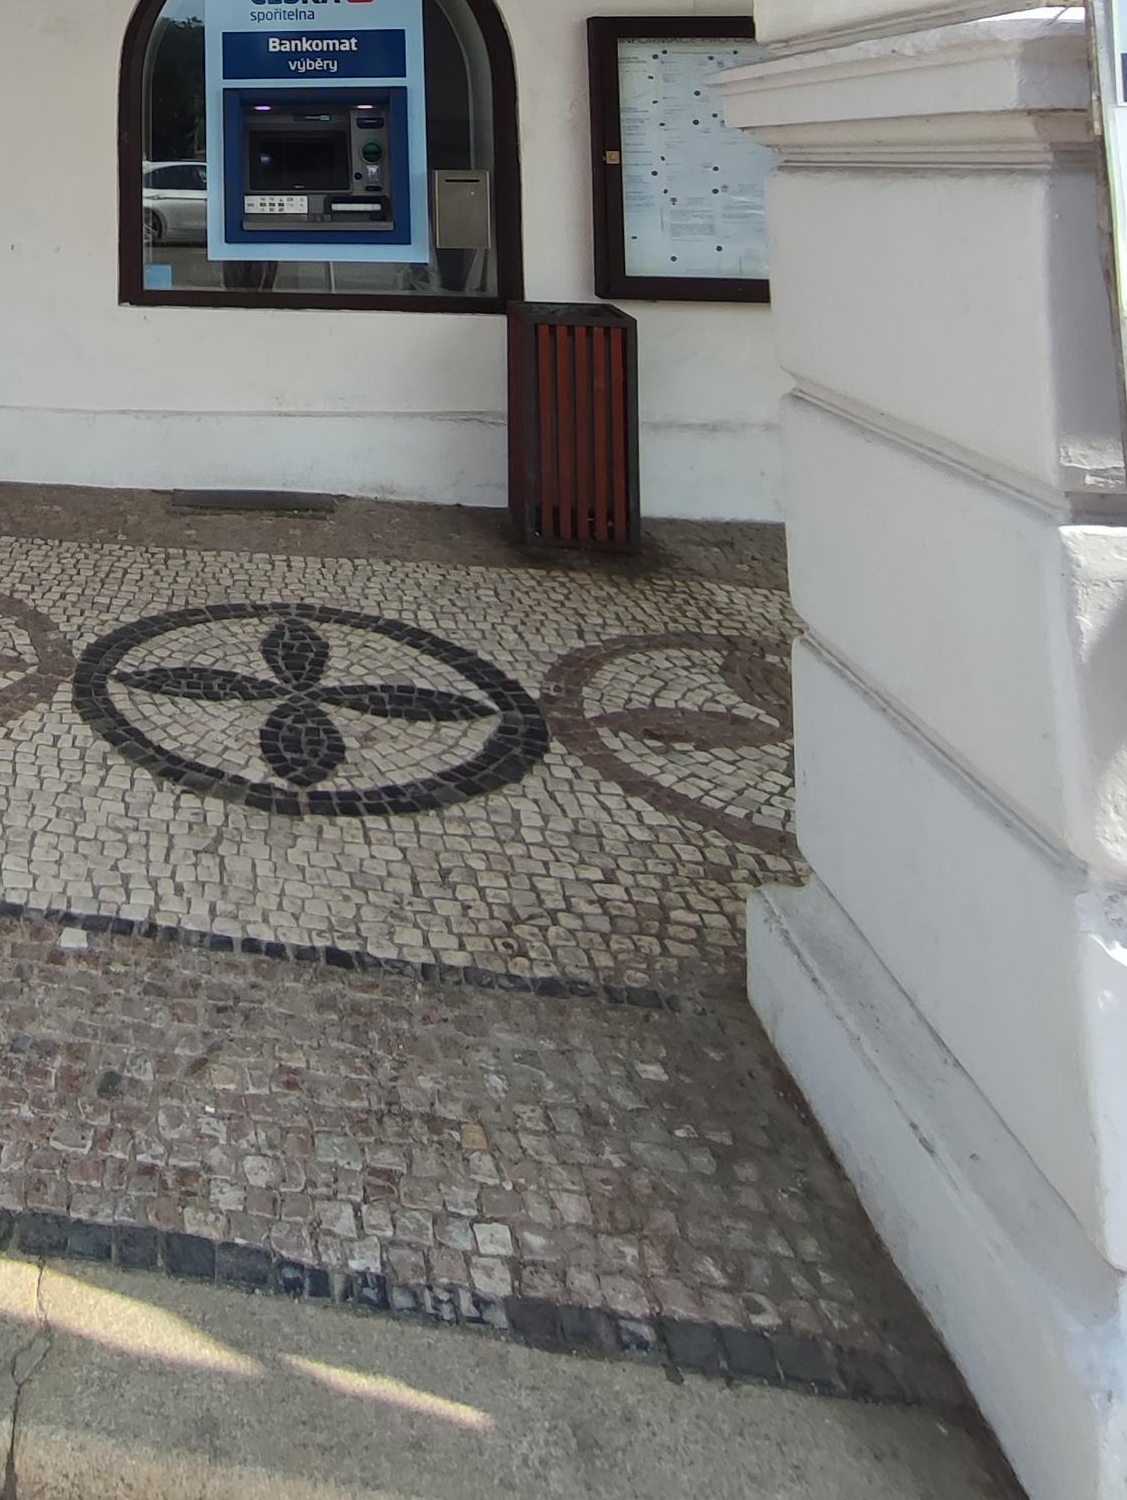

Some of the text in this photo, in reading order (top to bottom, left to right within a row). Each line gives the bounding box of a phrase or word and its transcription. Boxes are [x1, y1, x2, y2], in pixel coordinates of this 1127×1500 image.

[249, 8, 315, 24] spořitelna
[267, 37, 359, 53] Bankomat
[288, 57, 339, 73] výběry
